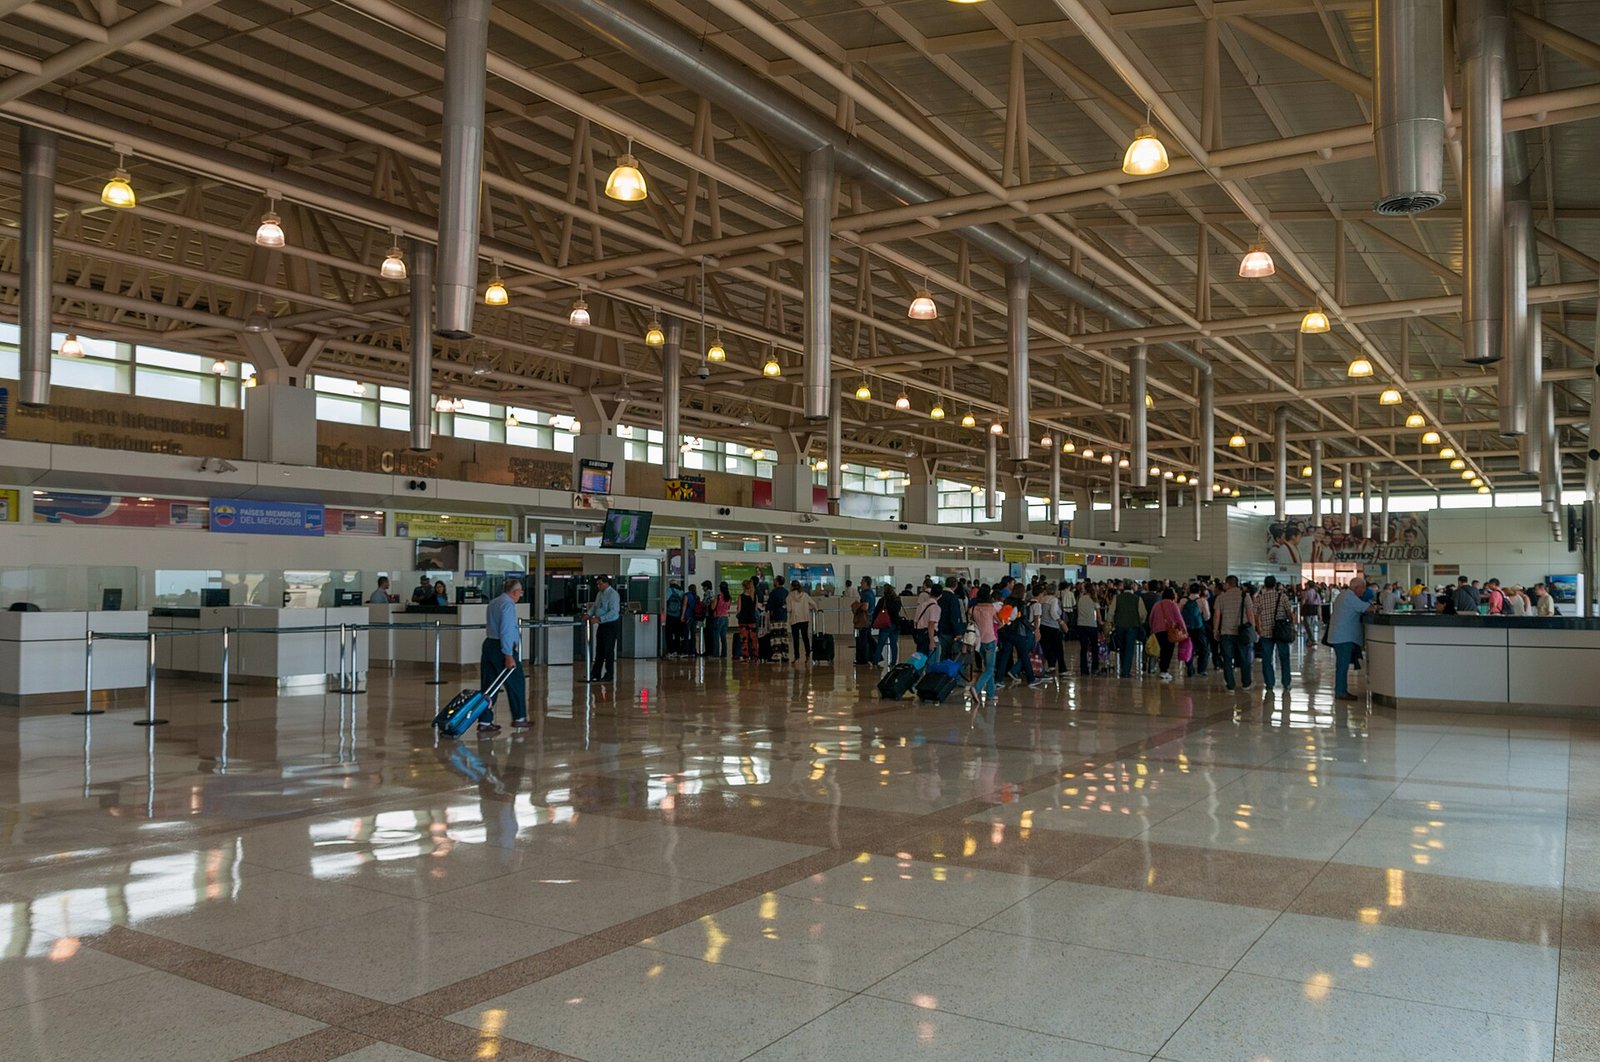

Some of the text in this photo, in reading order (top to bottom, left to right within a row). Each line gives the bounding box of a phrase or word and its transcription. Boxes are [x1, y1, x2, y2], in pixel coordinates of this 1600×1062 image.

[240, 507, 265, 517] PAÍSES
[265, 509, 302, 518] MIEMBROS
[240, 516, 256, 525] DEL
[257, 517, 302, 527] MERCOSUR
